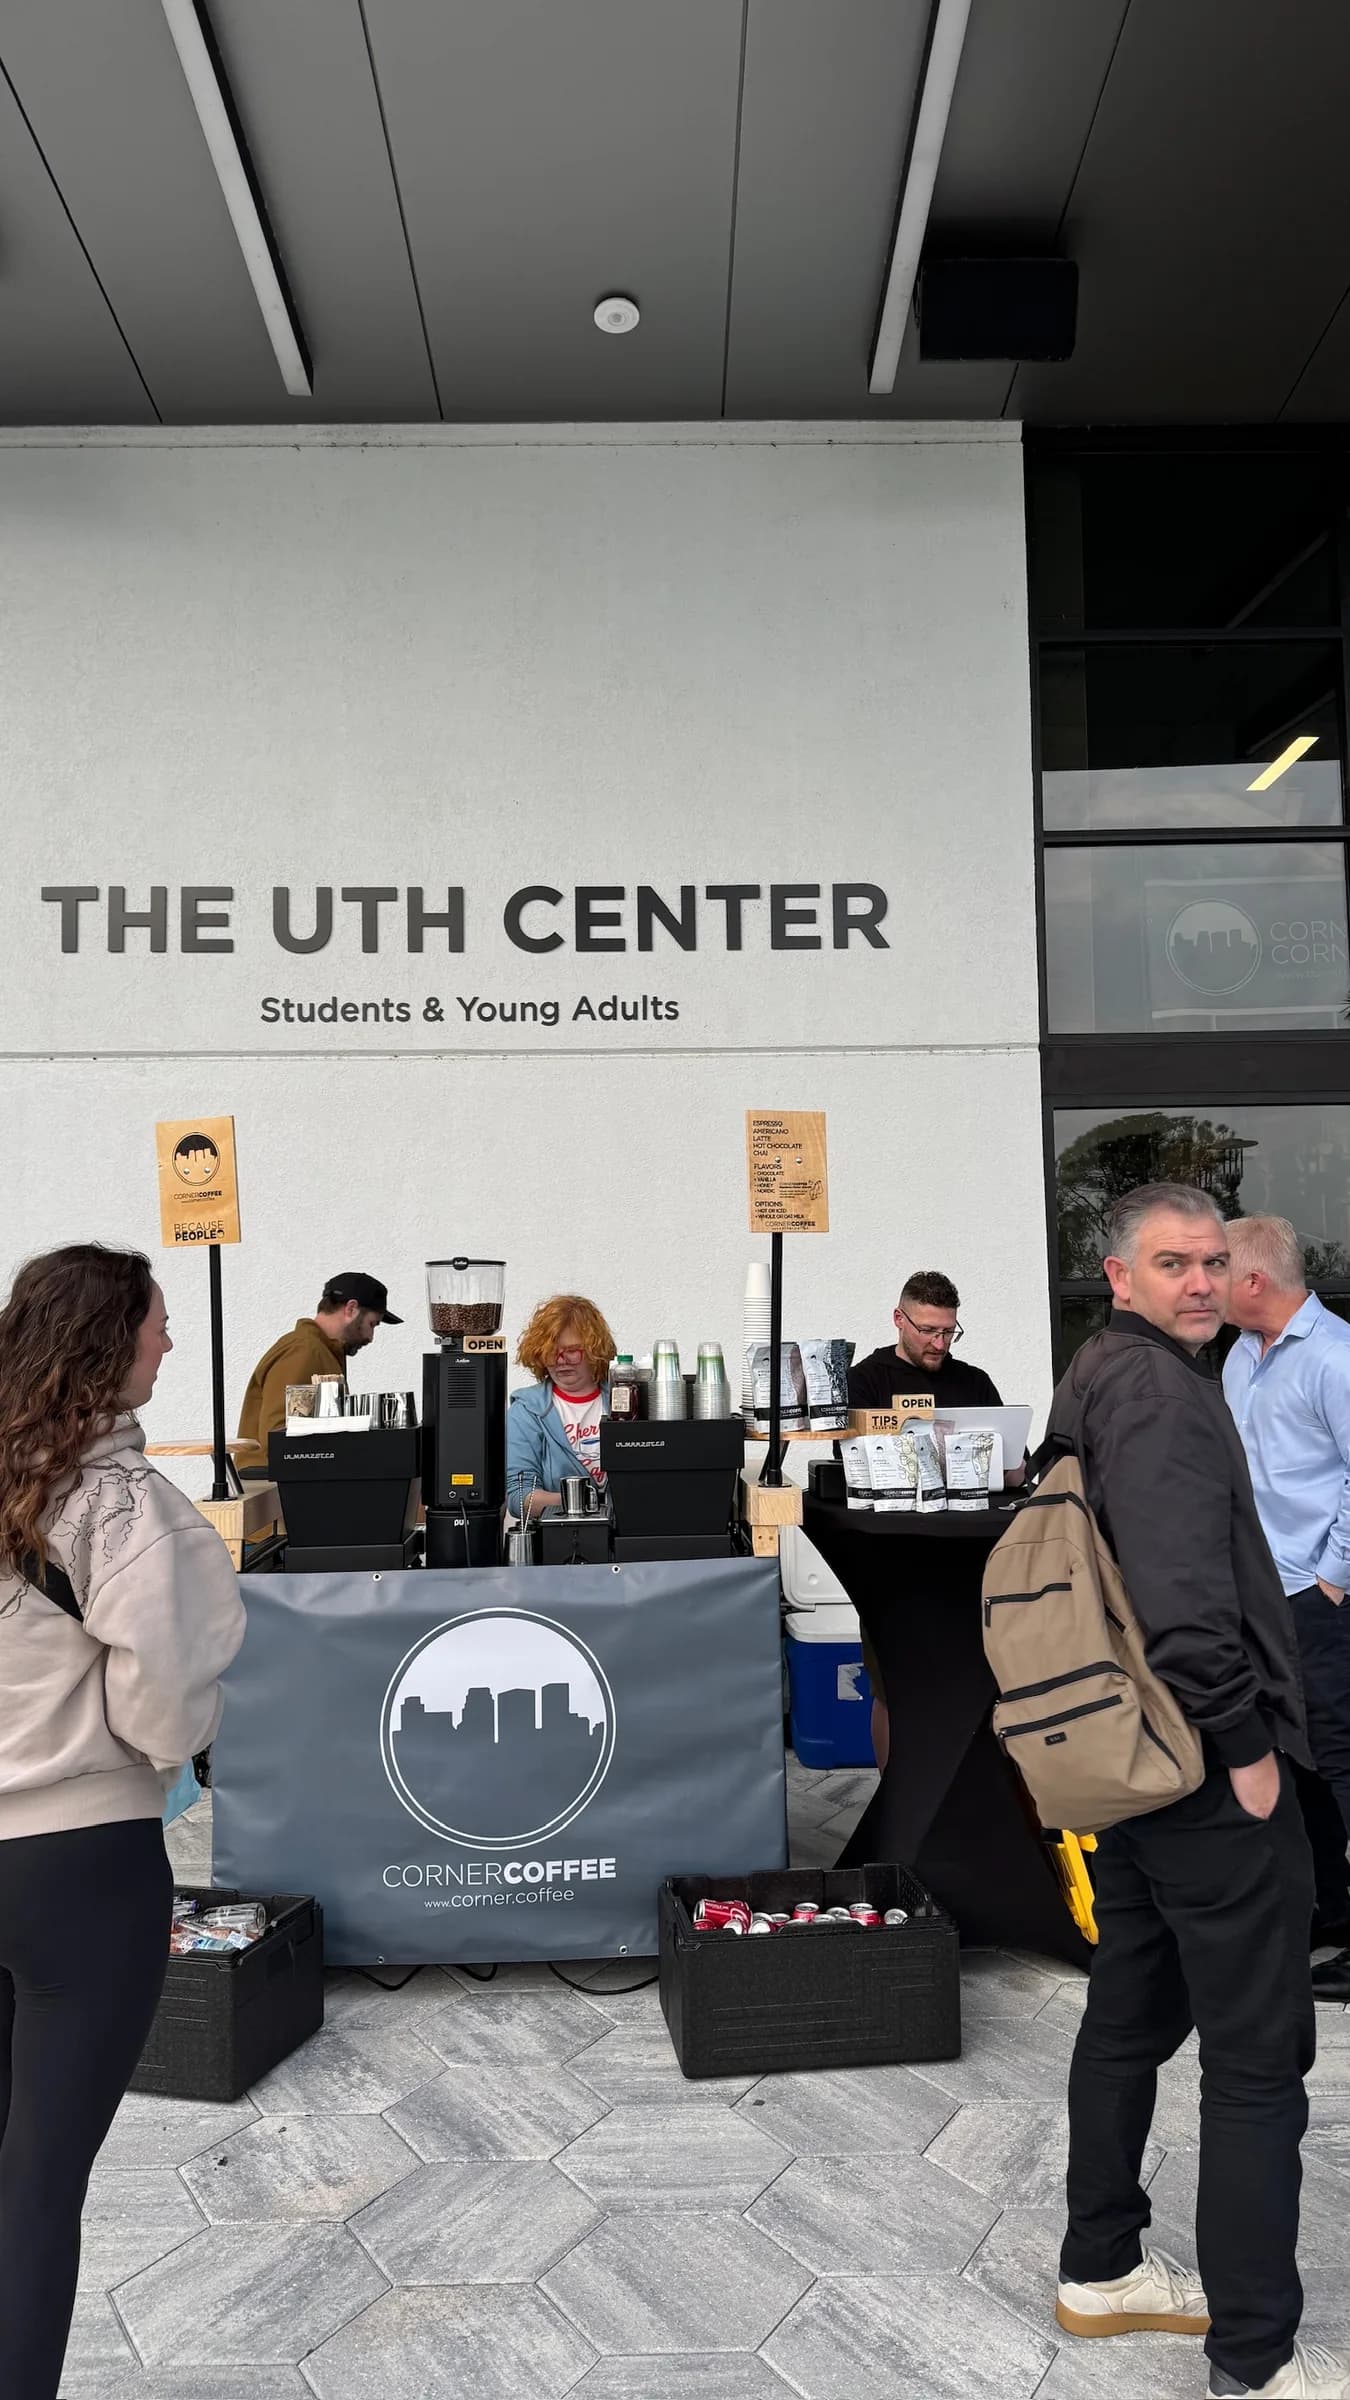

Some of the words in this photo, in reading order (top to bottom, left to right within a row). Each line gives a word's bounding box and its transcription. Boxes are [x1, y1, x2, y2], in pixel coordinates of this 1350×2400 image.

[41, 886, 235, 954] THE
[272, 886, 465, 954] UTH
[503, 882, 890, 953] CENTER
[260, 997, 411, 1023] Students
[422, 997, 445, 1022] &
[457, 997, 560, 1027] Young
[572, 995, 680, 1021] Adults
[174, 1220, 224, 1232] BECAUSE
[175, 1230, 217, 1241] PEOPLE
[468, 1340, 503, 1350] OPEN
[902, 1399, 932, 1408] OPEN
[872, 1416, 898, 1426] TIPS
[564, 1422, 600, 1445] Cher
[382, 1857, 617, 1888] CORNERCOFFEE
[424, 1887, 575, 1908] www.corner.coffee
